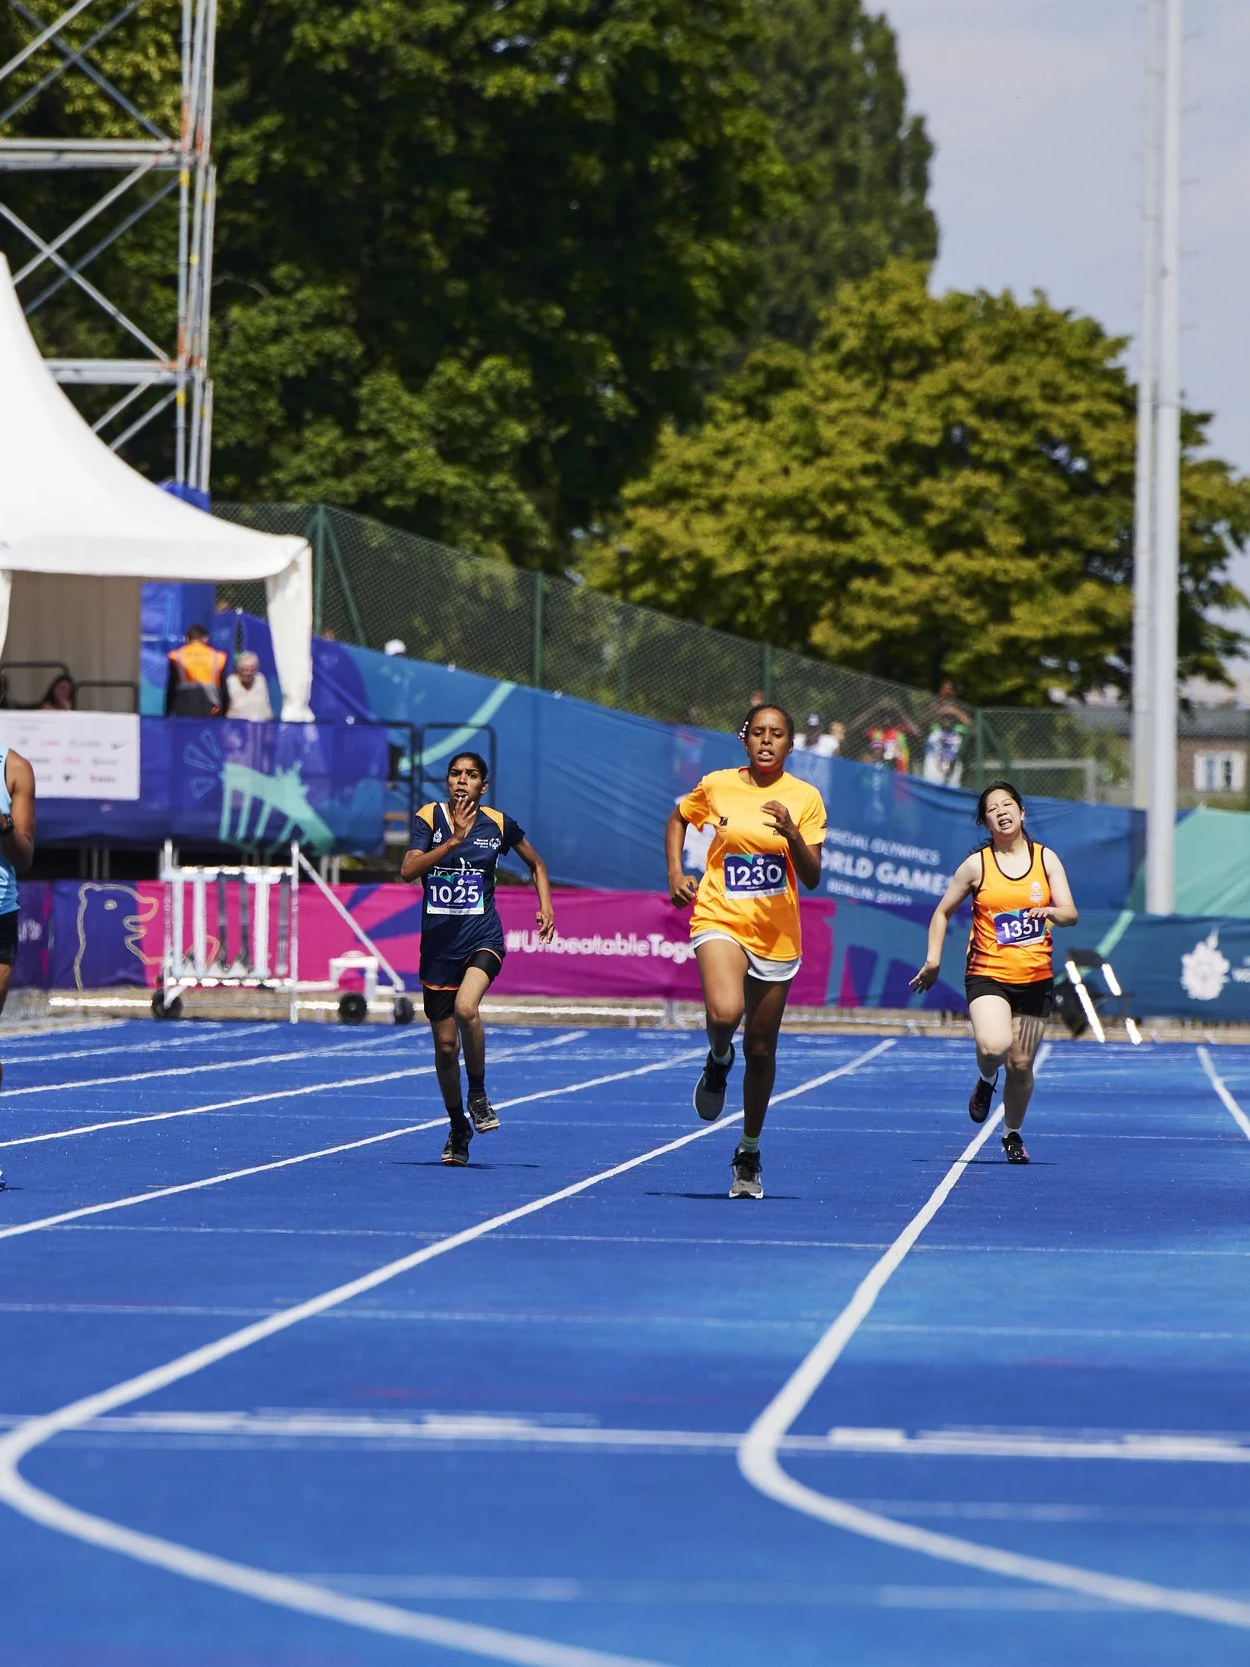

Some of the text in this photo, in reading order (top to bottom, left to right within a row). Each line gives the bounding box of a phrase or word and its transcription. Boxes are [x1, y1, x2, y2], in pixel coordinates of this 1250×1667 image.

[821, 846, 874, 879] ORLD
[727, 864, 782, 886] 1230
[430, 885, 480, 904] 1025
[826, 877, 876, 901] BERLIN
[1002, 919, 1039, 939] 1351
